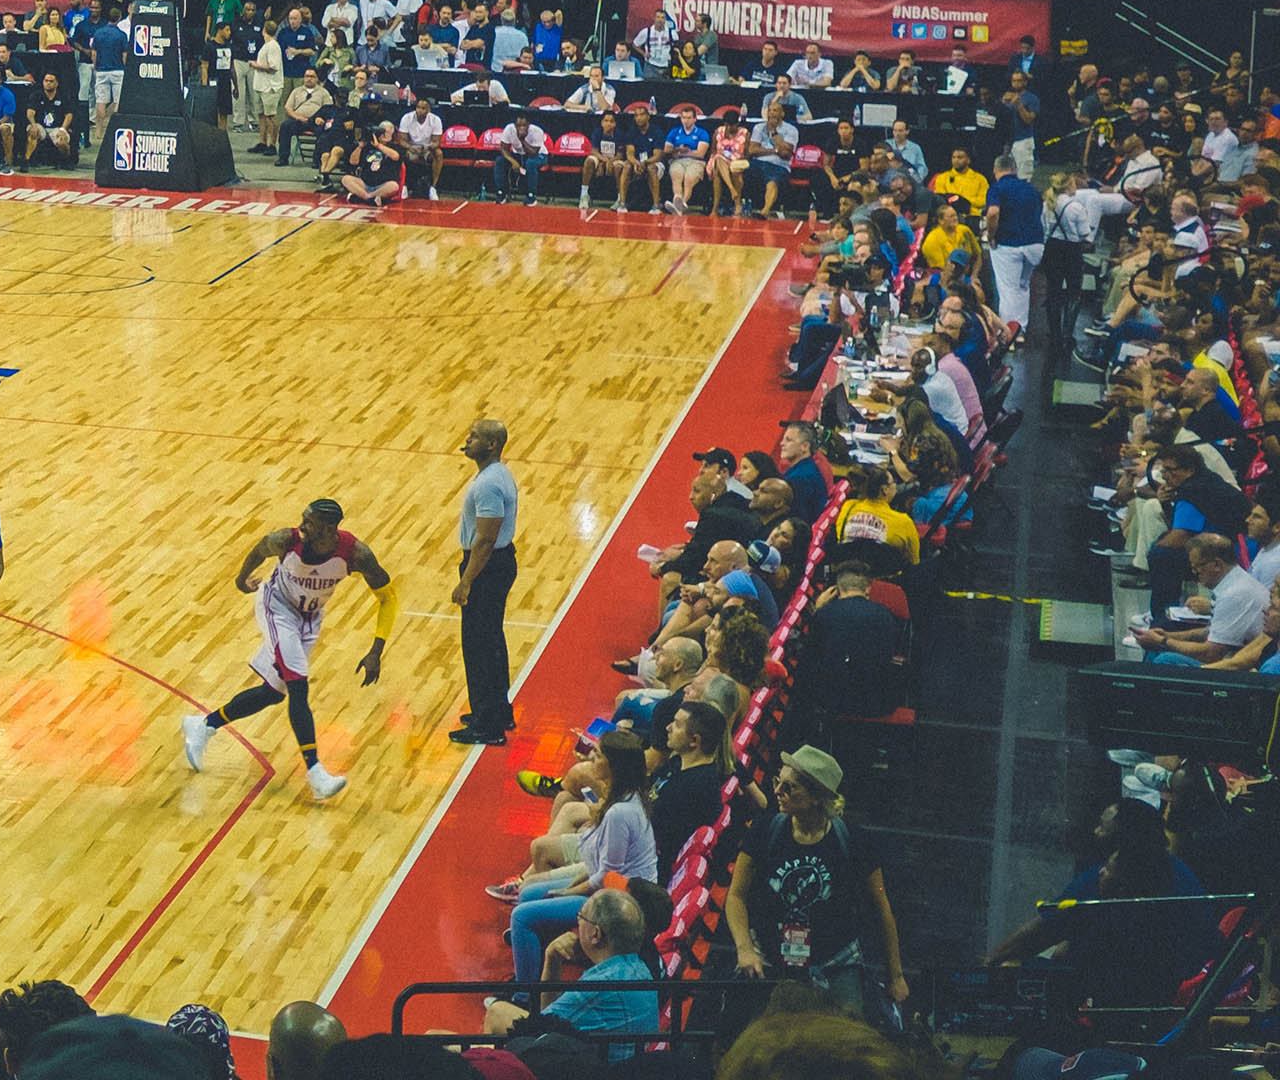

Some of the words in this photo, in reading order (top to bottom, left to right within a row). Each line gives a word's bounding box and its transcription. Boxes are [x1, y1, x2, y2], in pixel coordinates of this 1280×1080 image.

[766, 4, 833, 41] LEAGUE
[892, 4, 989, 23] #NBASummer
[139, 63, 164, 79] @NBA
[135, 135, 177, 155] SUMMER
[135, 154, 170, 172] LEAGUE
[170, 198, 384, 223] LEAGUE
